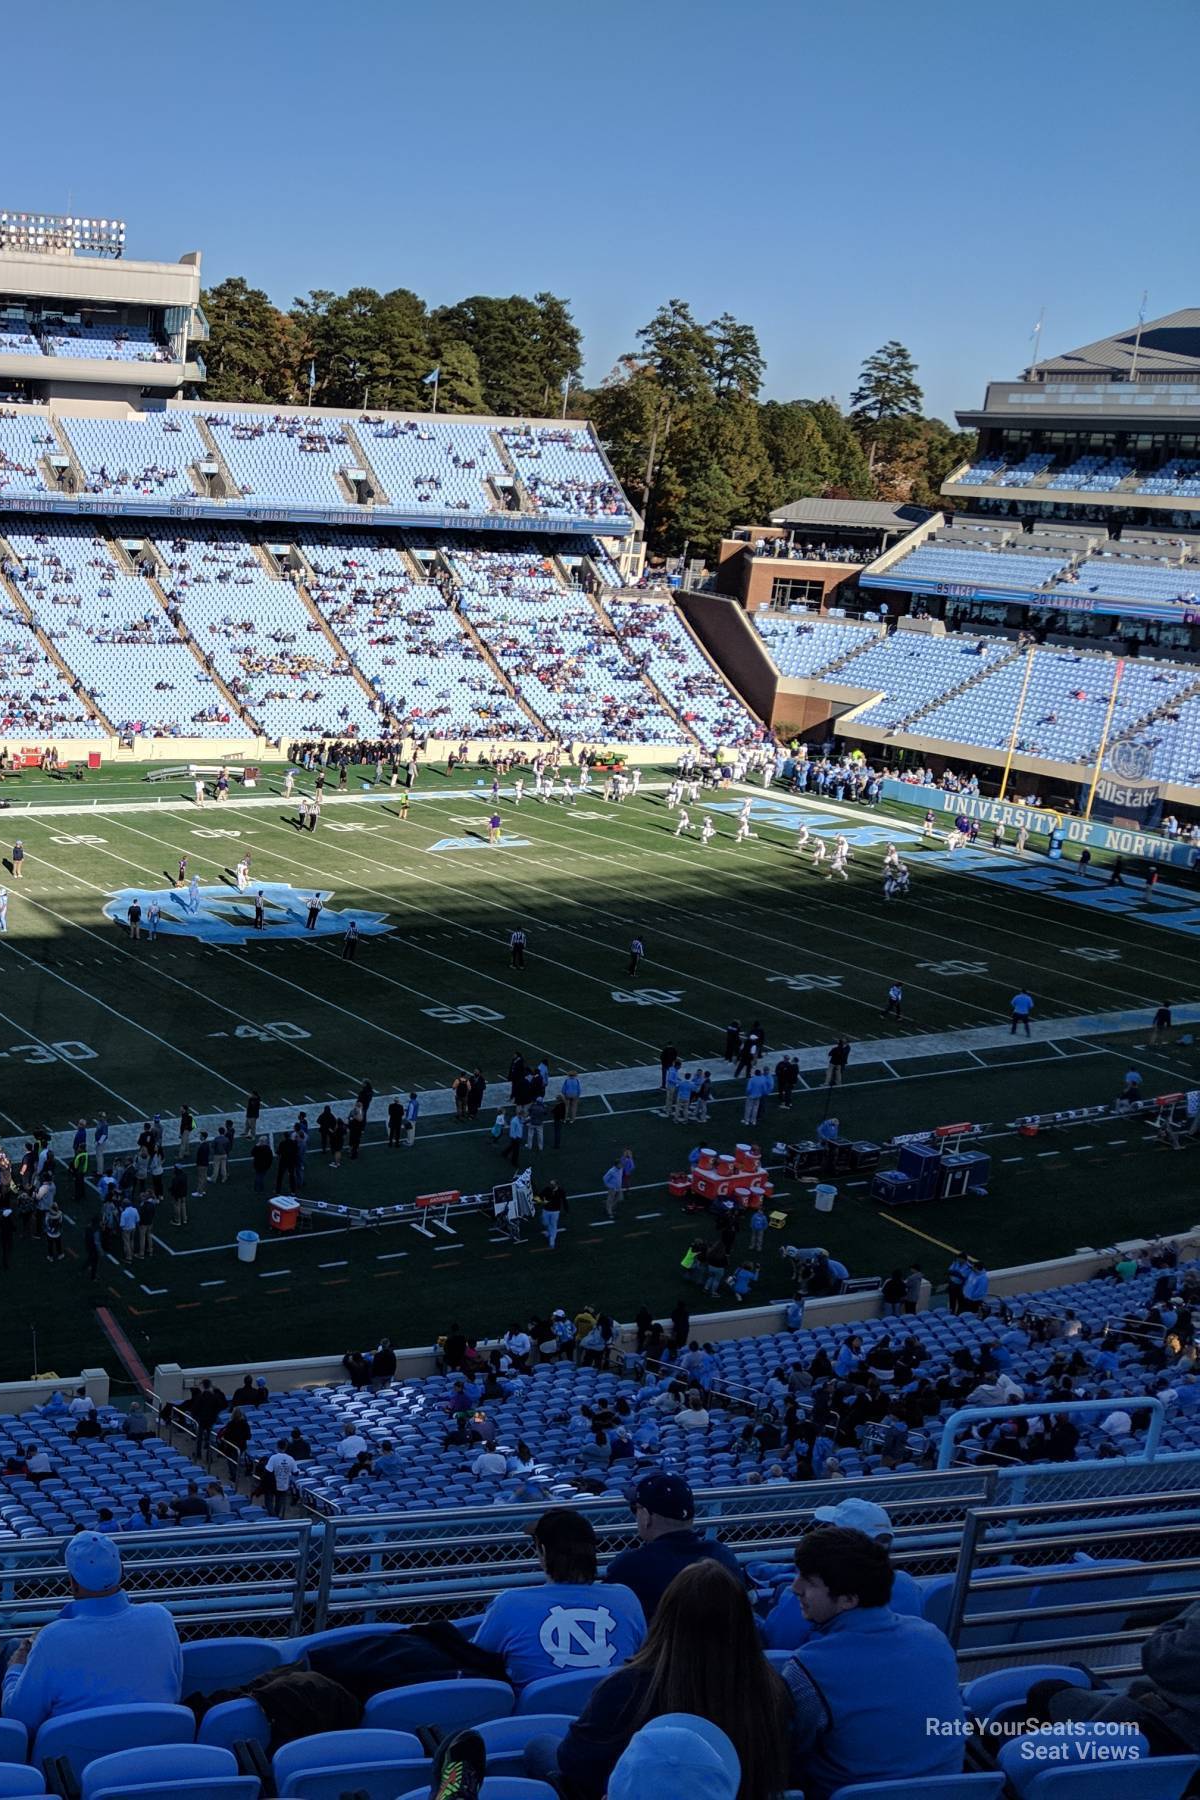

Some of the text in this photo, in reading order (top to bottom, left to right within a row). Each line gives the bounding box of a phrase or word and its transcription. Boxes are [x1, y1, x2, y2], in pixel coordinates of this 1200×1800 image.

[79, 502, 91, 512] 62
[170, 506, 182, 516] 68
[443, 518, 574, 532] WELCOME TO KENAN STADIUM
[942, 793, 1058, 836] UNIVERSITY
[1068, 822, 1094, 843] OF
[1104, 829, 1176, 863] NORTH
[49, 834, 109, 845] 50
[420, 1004, 506, 1024] 50
[234, 1021, 312, 1042] 40
[9, 1040, 100, 1065] 30
[271, 1209, 282, 1223] G
